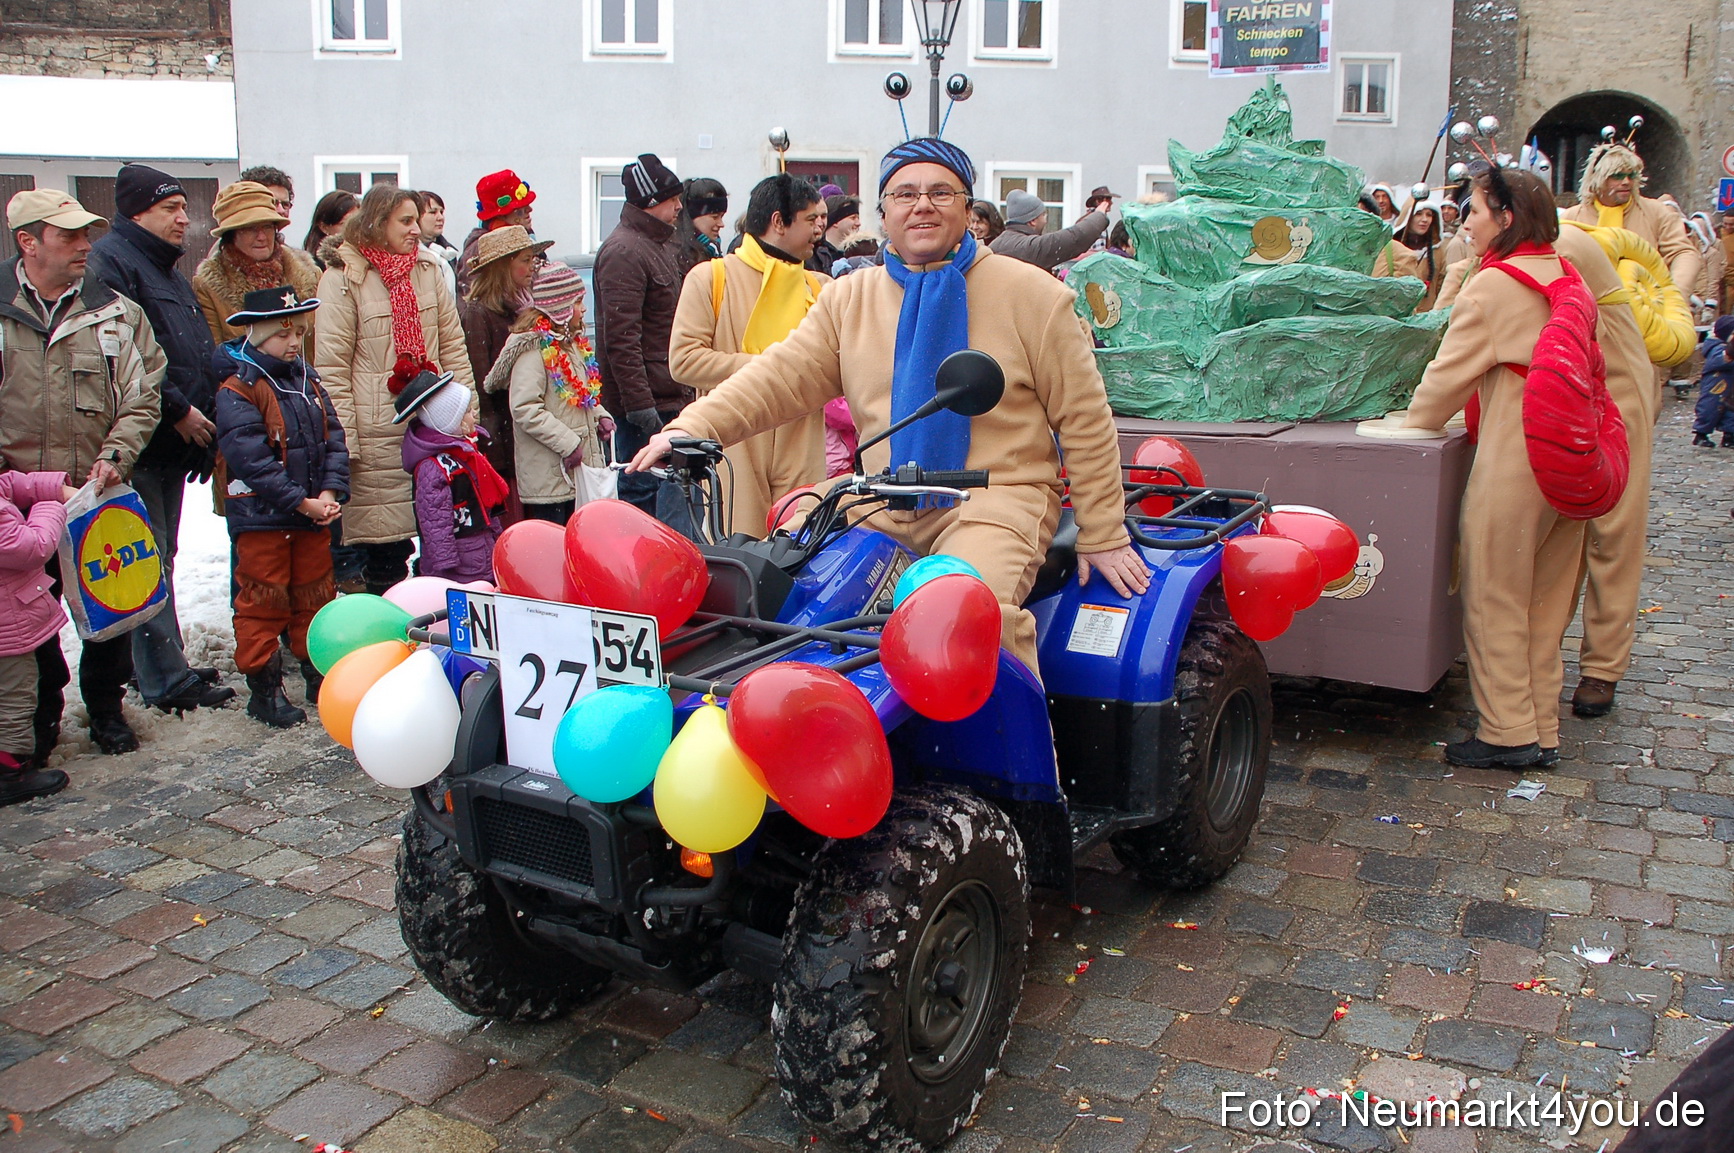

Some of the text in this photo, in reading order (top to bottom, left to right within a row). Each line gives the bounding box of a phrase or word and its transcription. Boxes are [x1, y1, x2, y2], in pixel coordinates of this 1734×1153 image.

[1226, 2, 1312, 22] FAHREN
[1236, 27, 1303, 41] Schnecken
[1249, 46, 1289, 59] tempo
[865, 558, 886, 588] YAMAHA
[456, 627, 465, 642] D
[515, 653, 588, 720] 27
